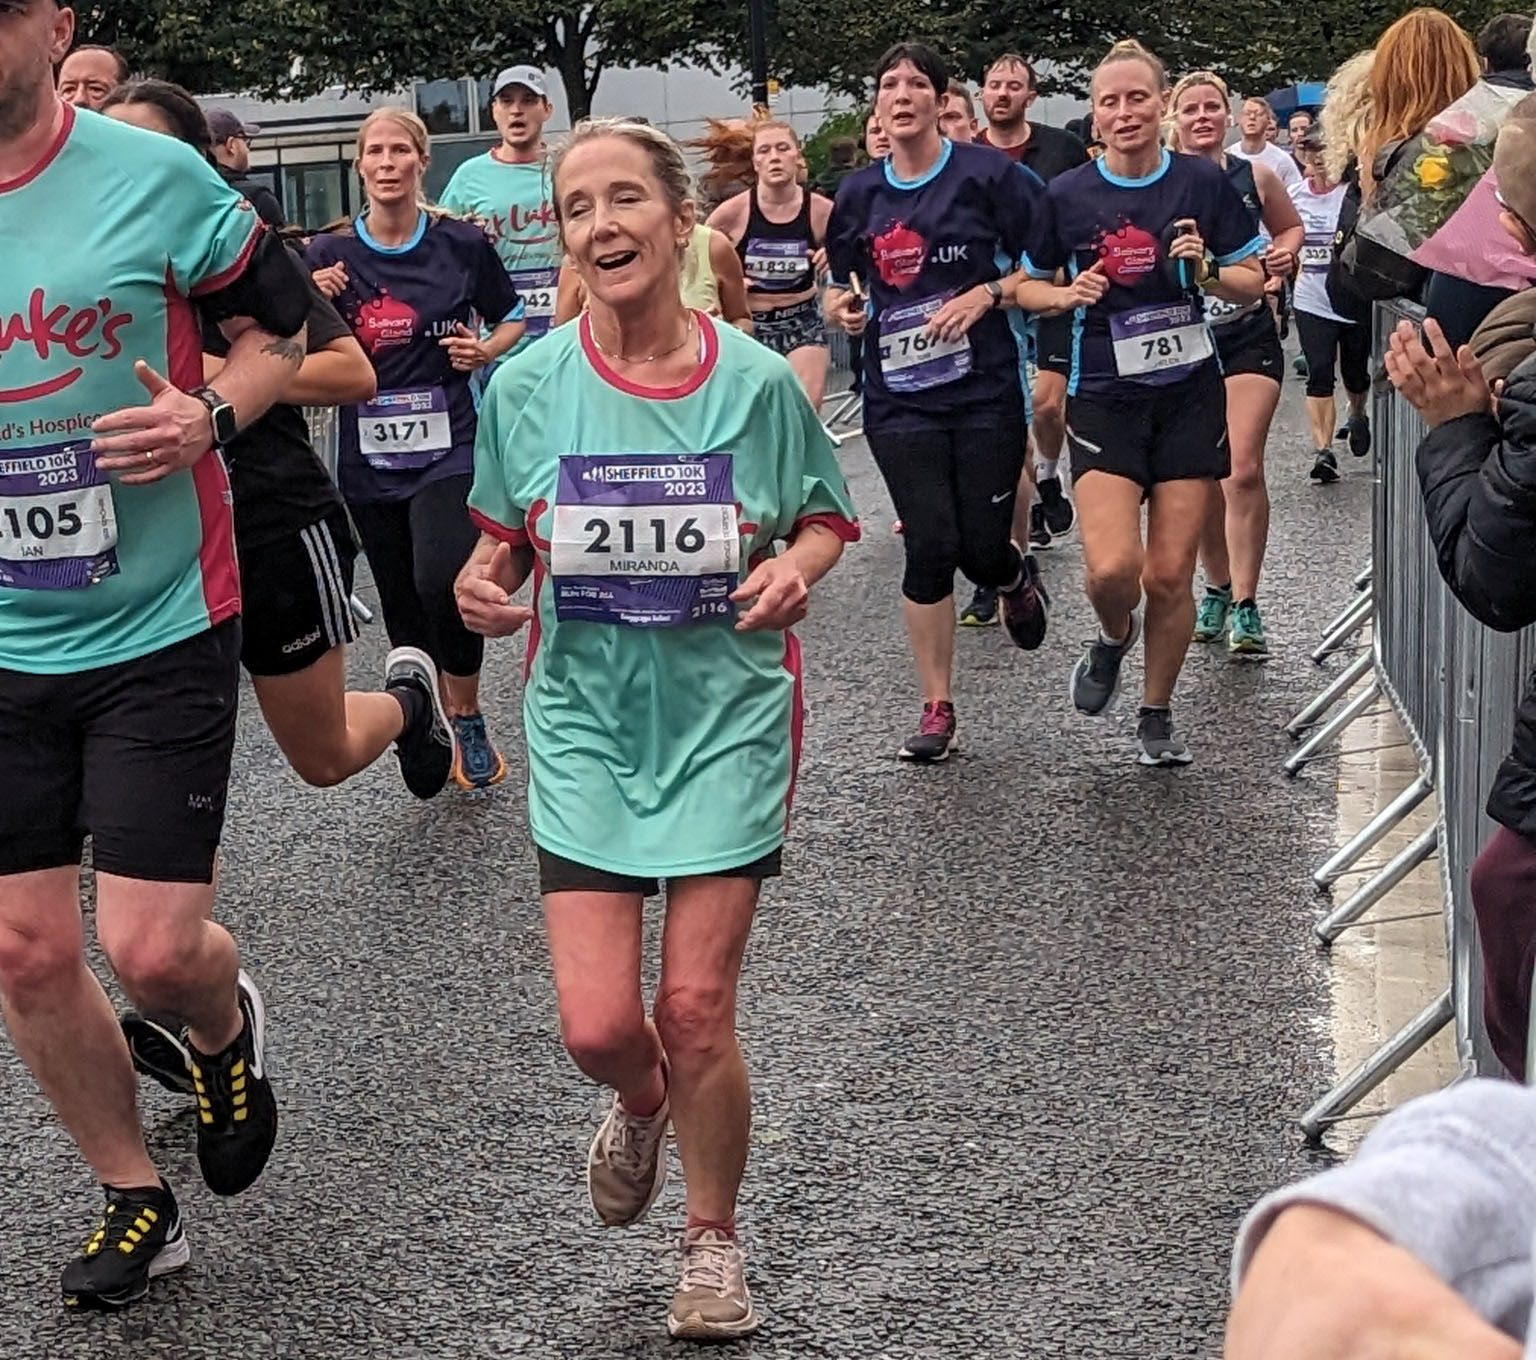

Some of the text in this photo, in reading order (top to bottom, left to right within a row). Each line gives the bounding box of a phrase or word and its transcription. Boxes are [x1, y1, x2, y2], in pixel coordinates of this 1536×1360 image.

[931, 244, 968, 263] .UK
[1141, 334, 1183, 360] 781
[373, 420, 429, 442] 3171
[49, 452, 75, 467] 10K
[37, 469, 79, 487] 2023
[606, 466, 704, 481] SHEFFIELD 10K
[664, 482, 707, 497] 2023
[584, 517, 706, 554] 2116
[21, 545, 44, 557] IAN
[609, 559, 681, 573] MIRANDA
[691, 602, 728, 619] 2116
[282, 625, 321, 653] adidas
